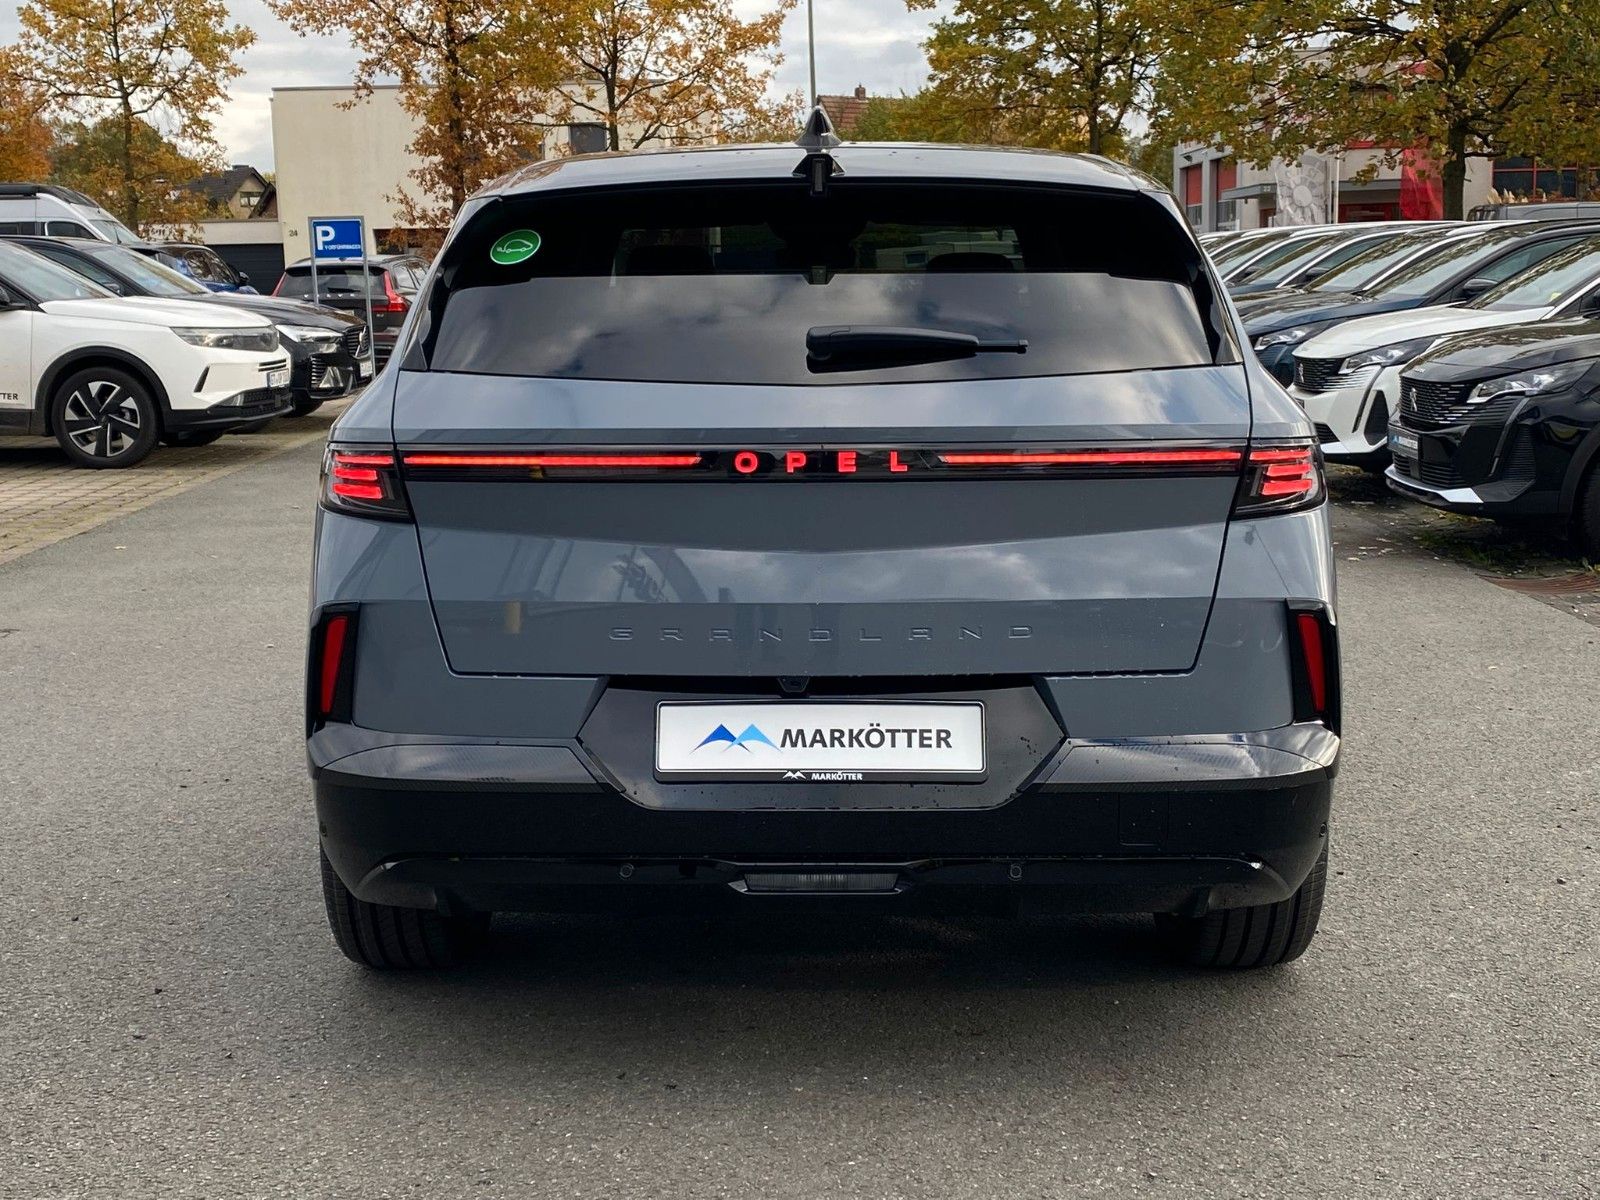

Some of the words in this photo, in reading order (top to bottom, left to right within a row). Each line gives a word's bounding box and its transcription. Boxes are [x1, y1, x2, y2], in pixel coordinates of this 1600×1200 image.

[316, 225, 335, 250] P
[734, 451, 908, 473] OPEL
[608, 625, 1034, 641] GRANDLAND
[780, 723, 952, 749] MARKÖTTER
[811, 770, 863, 781] MARKÖTTER
